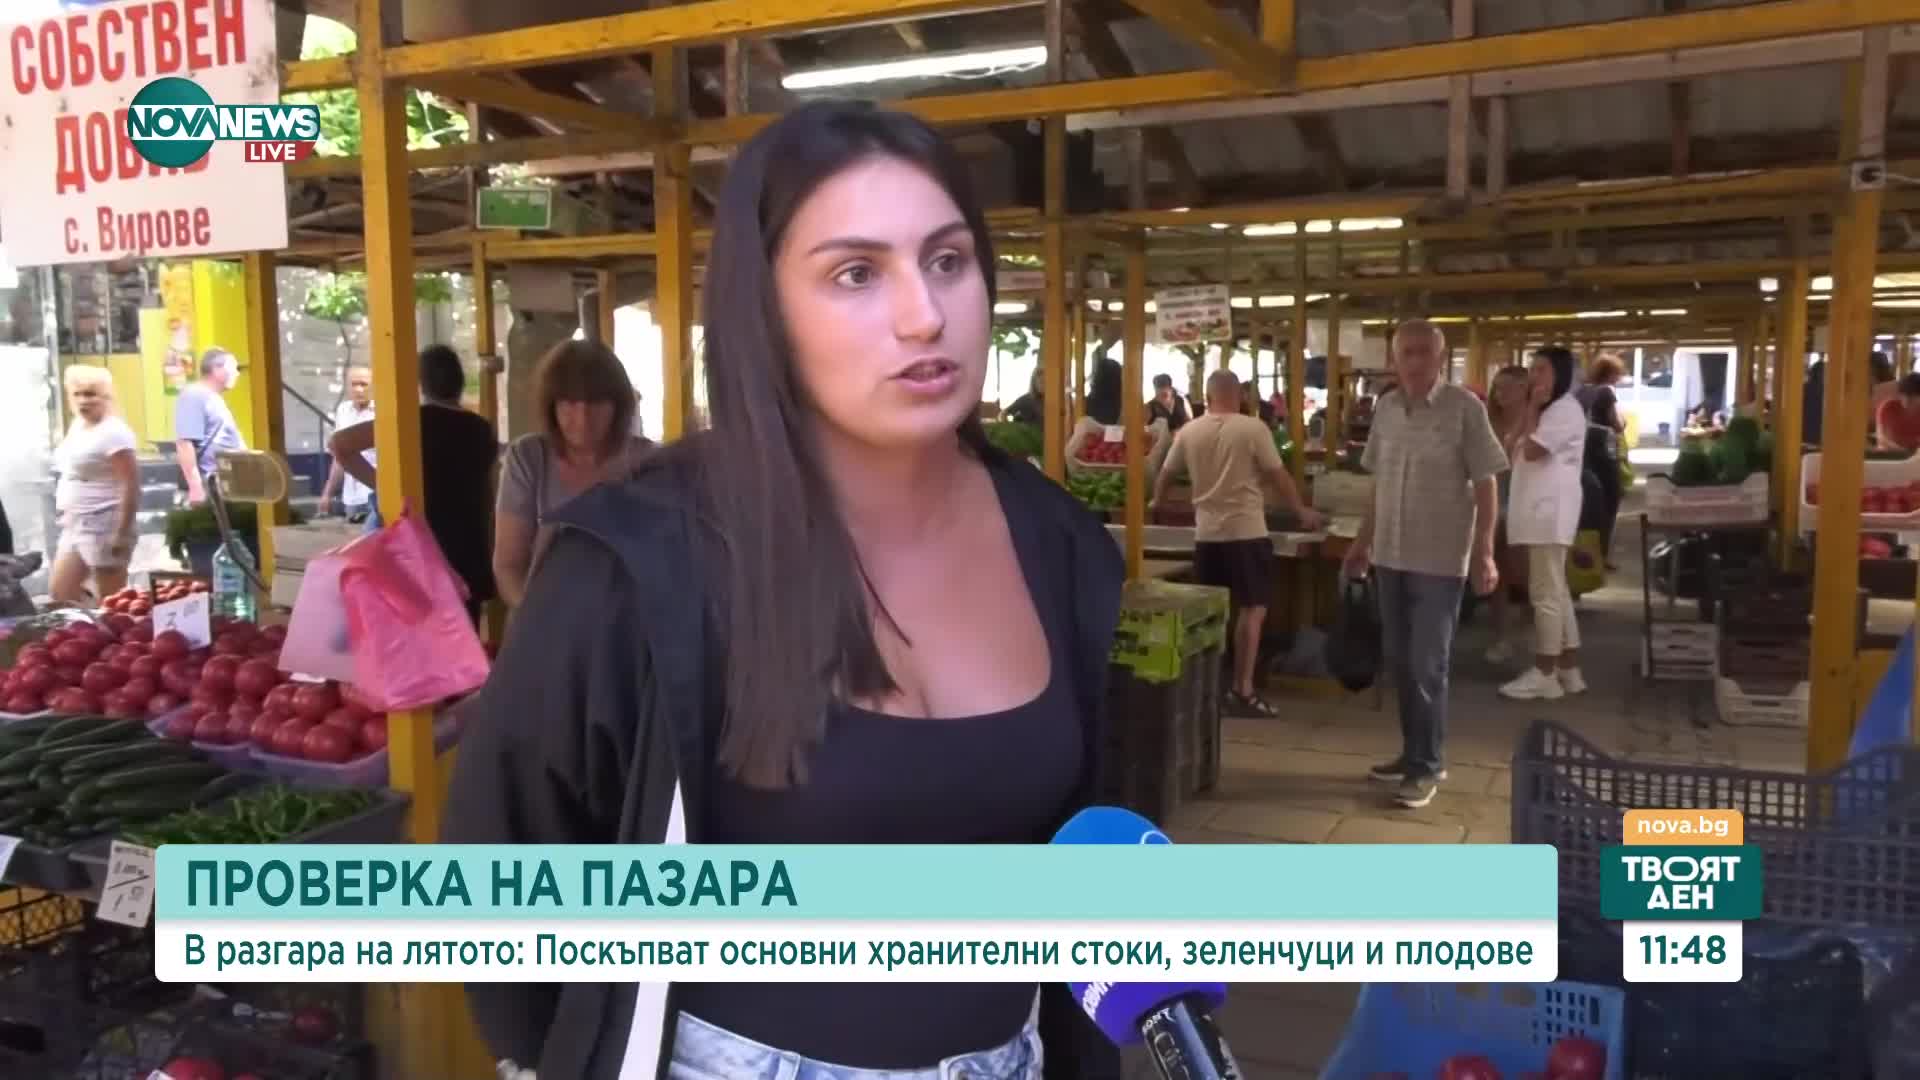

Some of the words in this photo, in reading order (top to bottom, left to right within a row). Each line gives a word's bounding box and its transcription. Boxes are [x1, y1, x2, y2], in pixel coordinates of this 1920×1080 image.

[10, 0, 246, 95] СОБСТВЕН
[55, 105, 211, 195] ДОБ
[97, 206, 211, 255] Вирове
